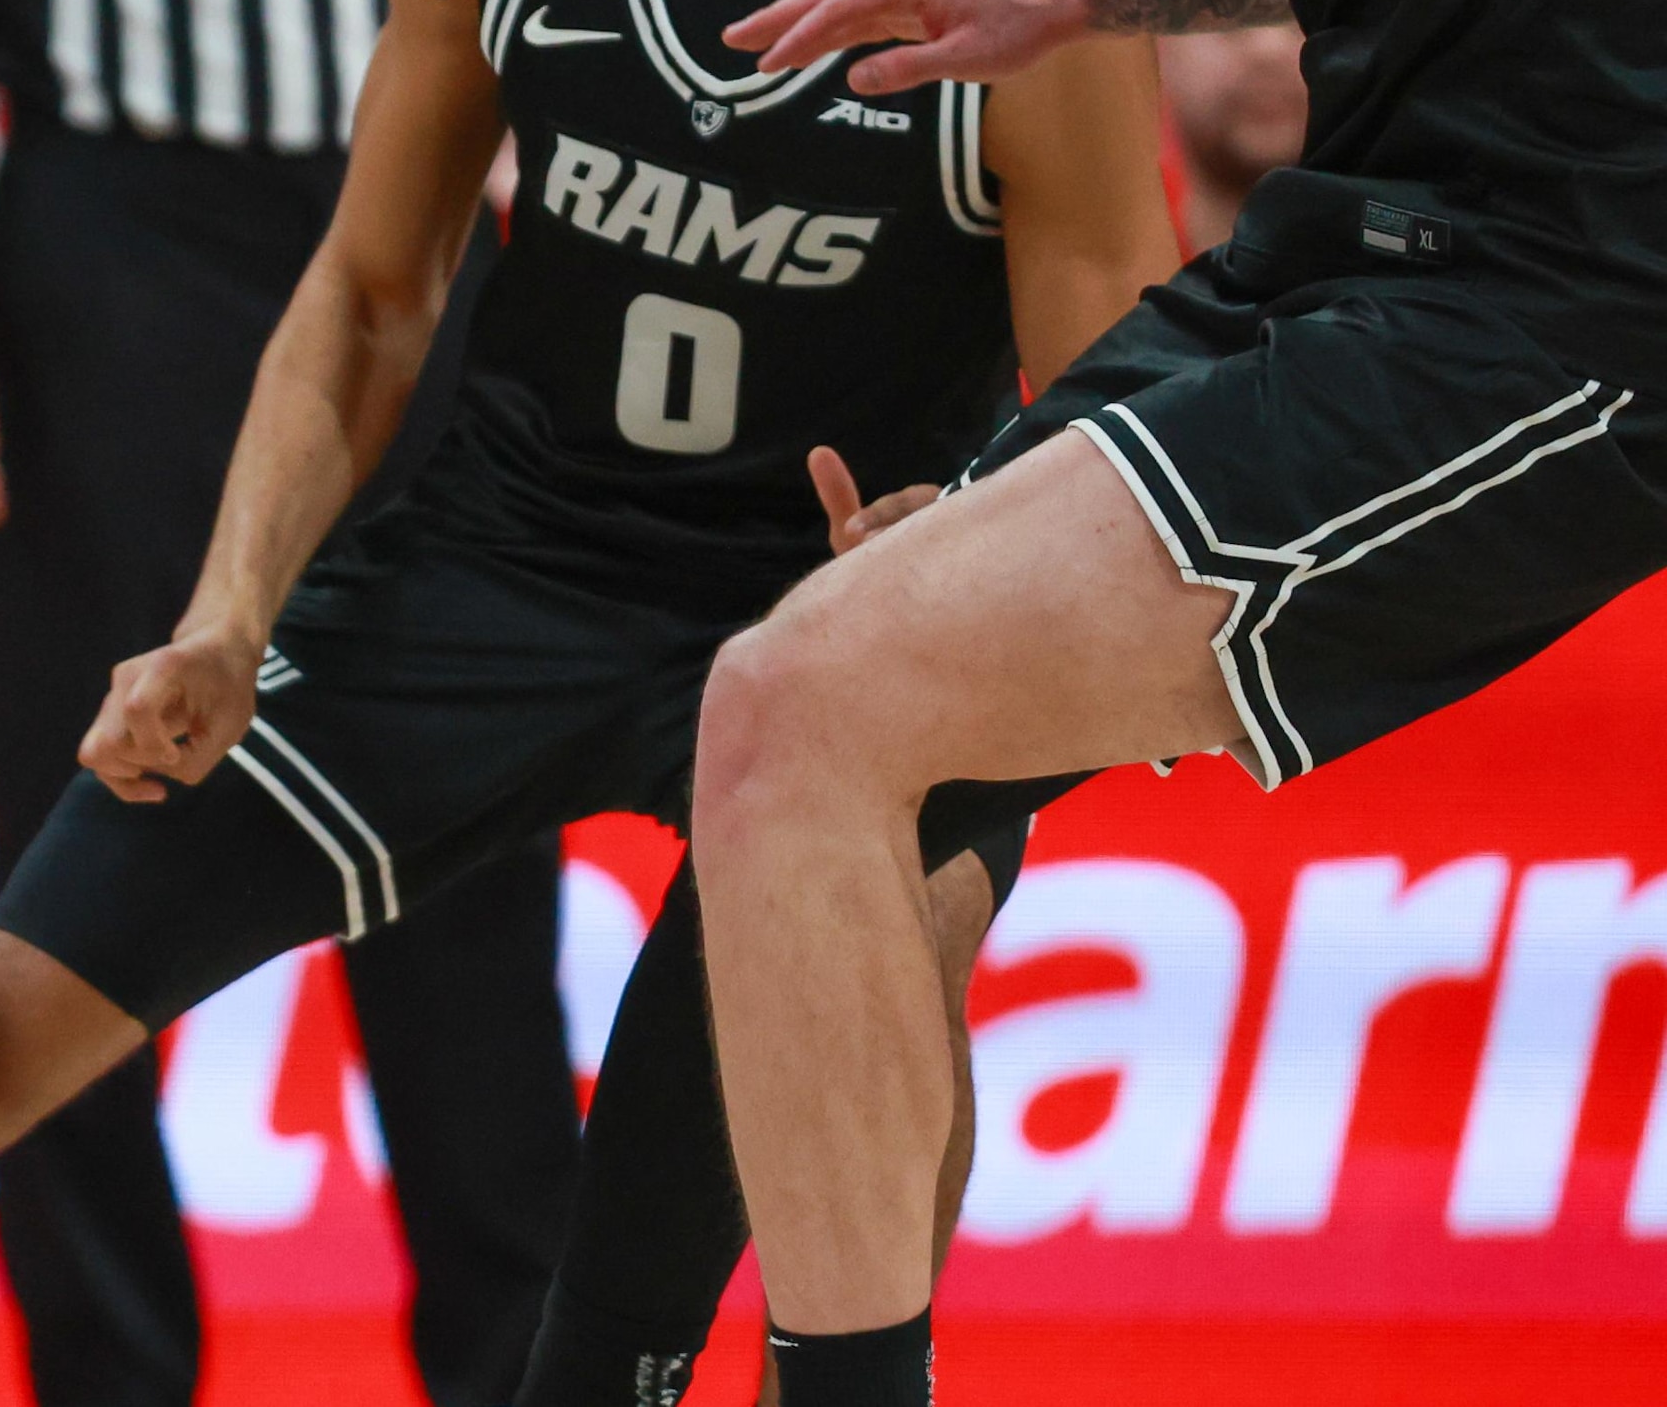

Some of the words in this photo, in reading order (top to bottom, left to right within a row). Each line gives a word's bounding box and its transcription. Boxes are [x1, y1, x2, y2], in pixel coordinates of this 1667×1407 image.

[817, 96, 912, 133] A10
[543, 132, 882, 288] RAMS
[1419, 228, 1439, 251] XL
[615, 292, 743, 455] 0
